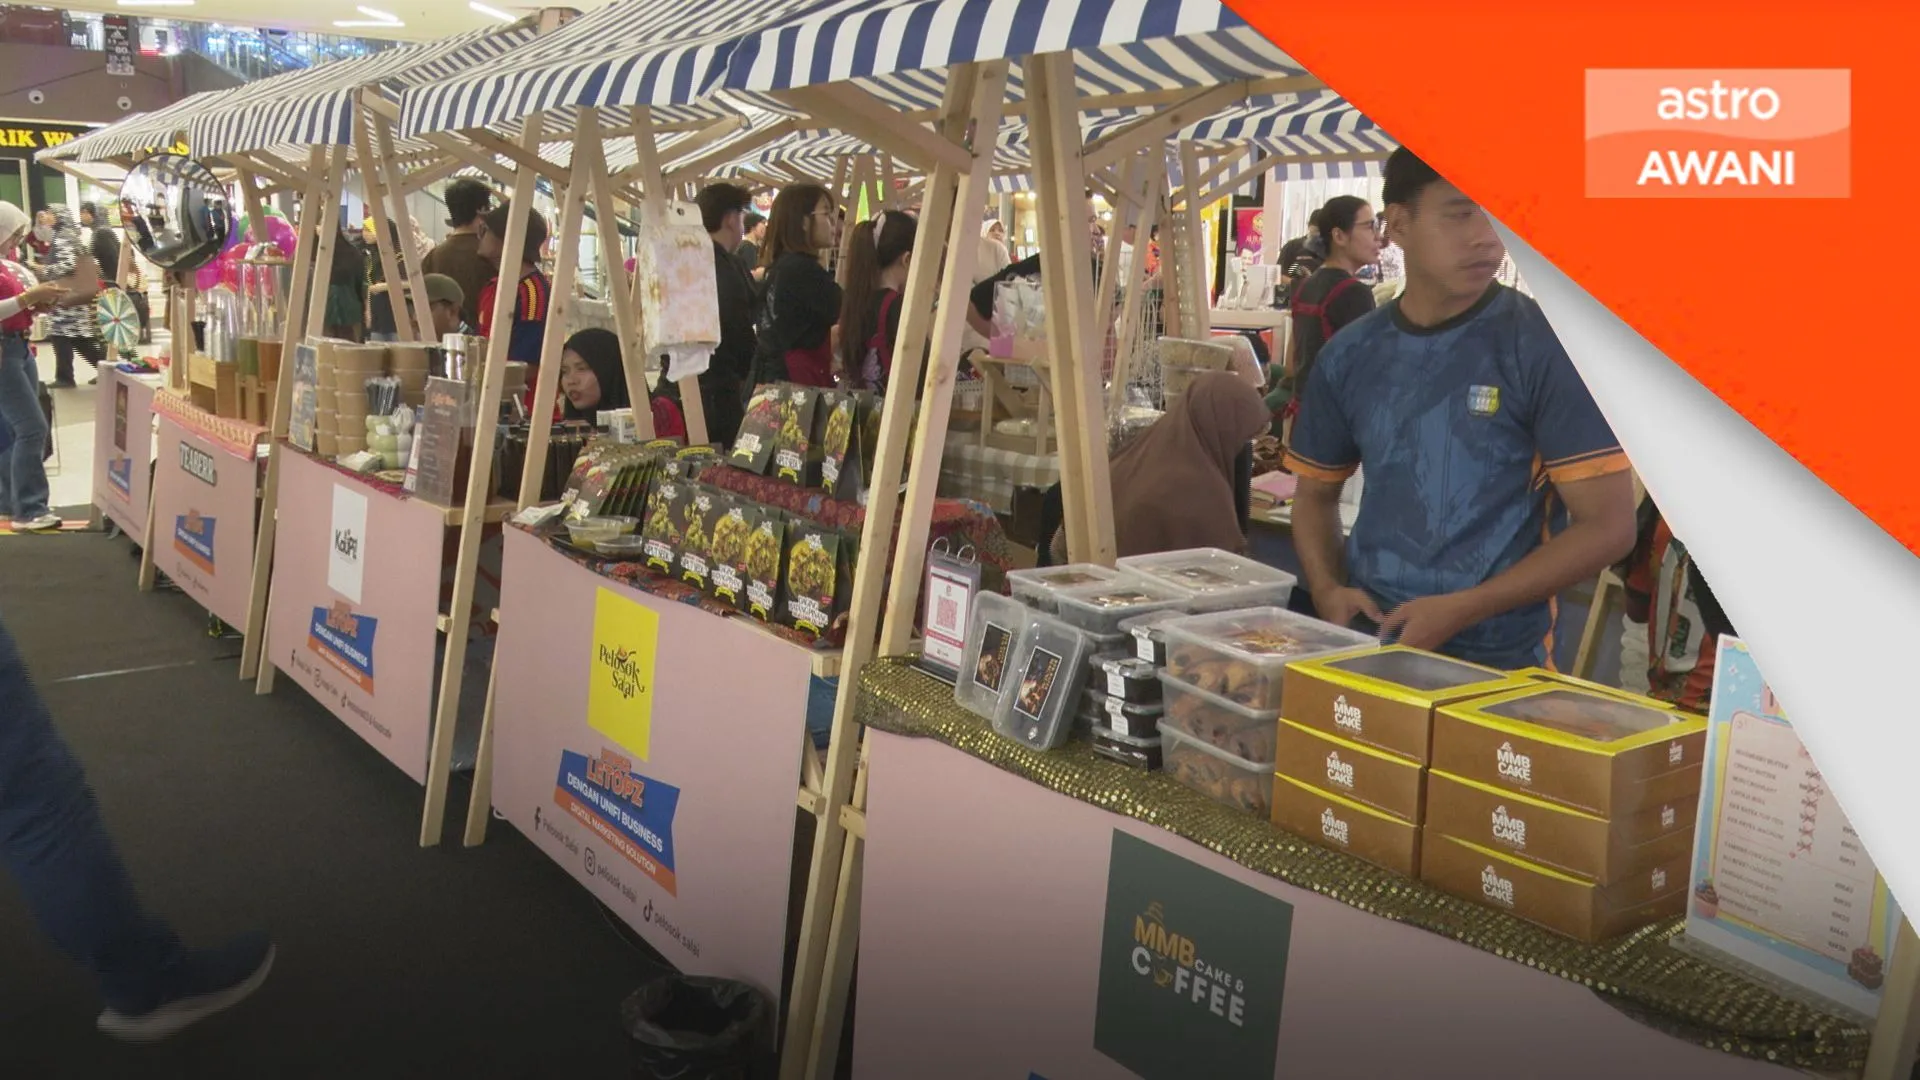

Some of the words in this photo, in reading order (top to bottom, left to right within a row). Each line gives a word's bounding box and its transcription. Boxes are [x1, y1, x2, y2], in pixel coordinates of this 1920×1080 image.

[1334, 702, 1361, 718] MMB
[1334, 713, 1362, 731] CAKE
[1326, 757, 1353, 775] MMB
[1497, 749, 1530, 768] MMB
[1327, 769, 1354, 788] CAKE
[1498, 762, 1531, 781] CAKE
[567, 771, 599, 806] DENGAN
[600, 795, 620, 821] UNIFI
[621, 811, 663, 853] BUSINESS
[1321, 812, 1348, 831] MMB
[1492, 811, 1525, 832] MMB
[570, 801, 592, 826] DIGITAL
[591, 817, 625, 850] MARKETING
[625, 844, 656, 875] SOLUTION
[1322, 825, 1349, 844] CAKE
[1492, 825, 1526, 846] CAKE
[1481, 870, 1513, 892] MMB
[1482, 884, 1514, 905] CAKE
[1134, 914, 1195, 968] MMB
[1195, 959, 1232, 988] CAKE
[1235, 978, 1244, 993] &
